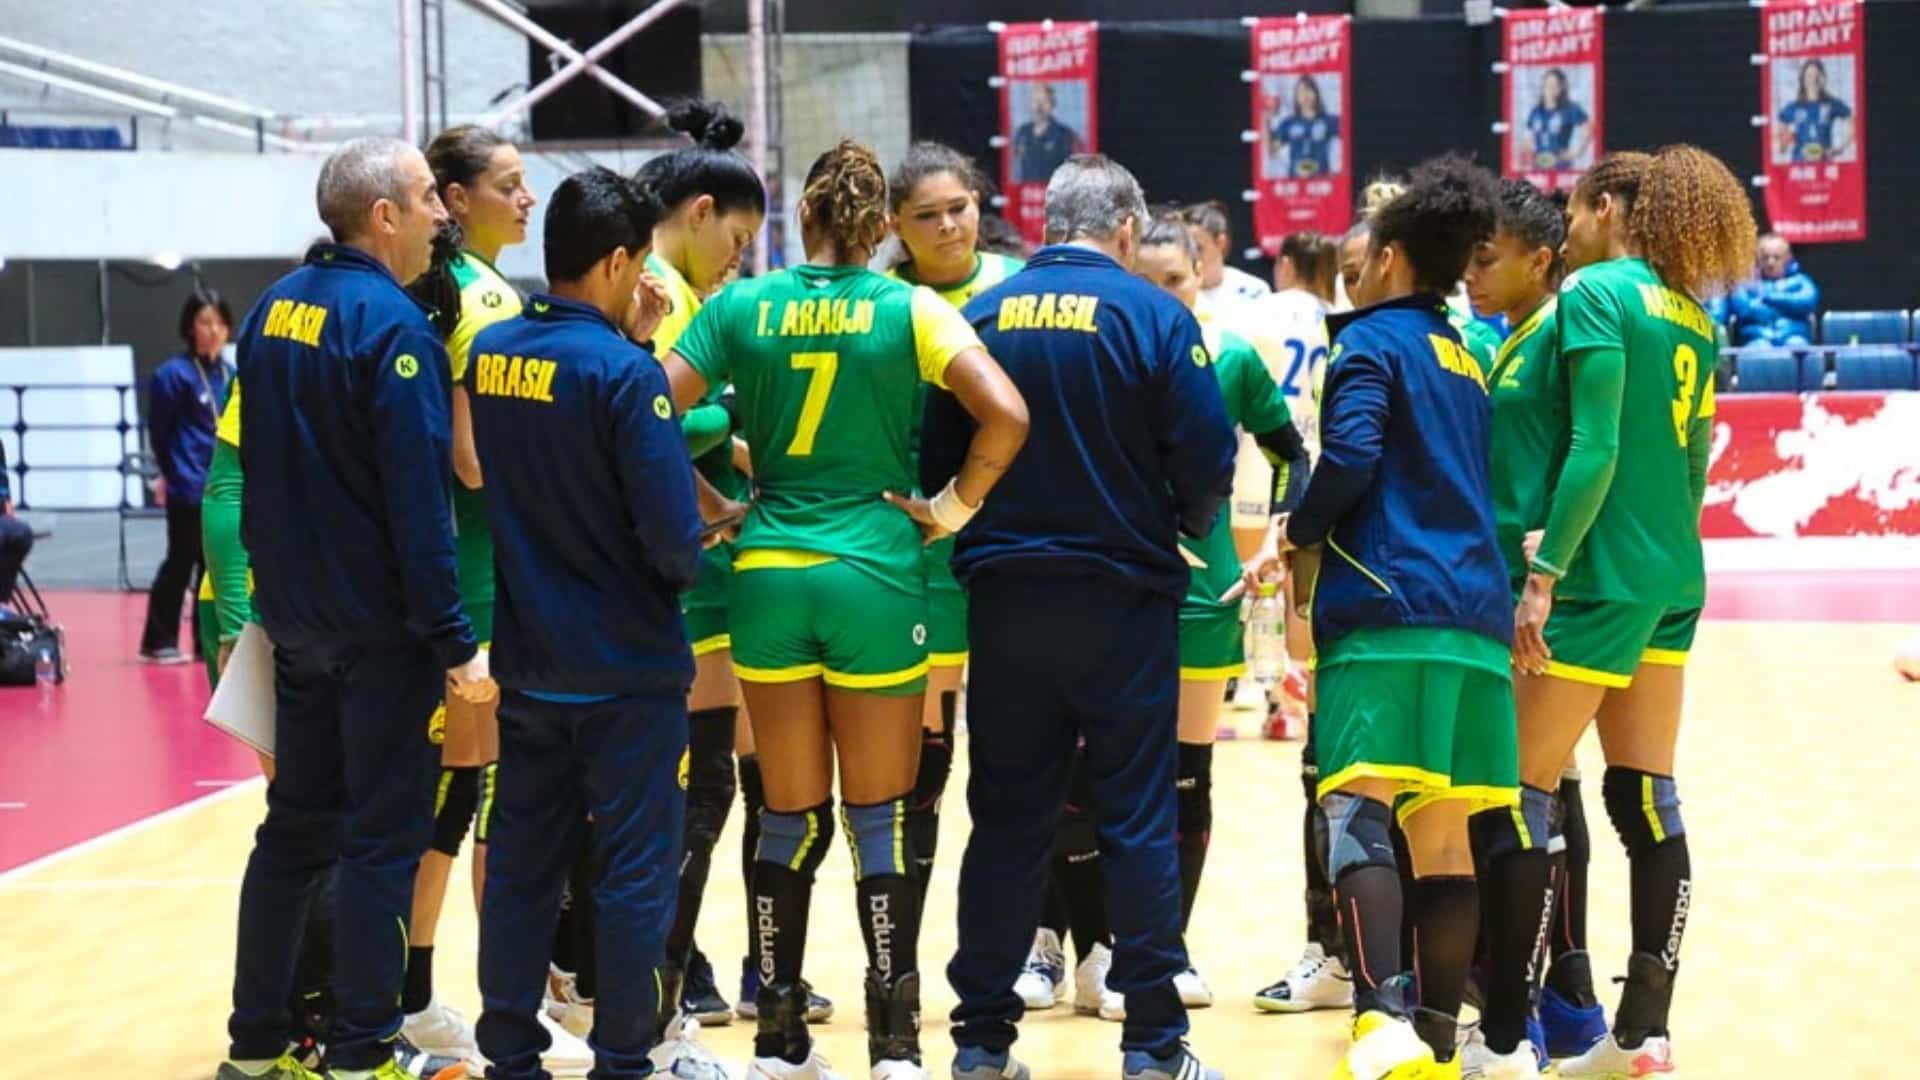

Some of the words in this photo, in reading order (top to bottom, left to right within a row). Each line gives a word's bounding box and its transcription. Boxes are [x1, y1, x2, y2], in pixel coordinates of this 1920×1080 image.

[1510, 11, 1595, 41] BRAVE
[1768, 2, 1855, 33] BRAVE
[1006, 29, 1089, 55] BRAVE
[1260, 20, 1343, 50] BRAVE
[1510, 31, 1595, 62] HEART
[1768, 21, 1855, 54] HEART
[1006, 48, 1089, 76] HEART
[1260, 41, 1342, 70] HEART
[262, 299, 328, 346] BRASIL
[996, 293, 1099, 332] BRASIL
[475, 353, 557, 402] BRASIL
[786, 352, 838, 455] 7
[1672, 343, 1697, 448] 3
